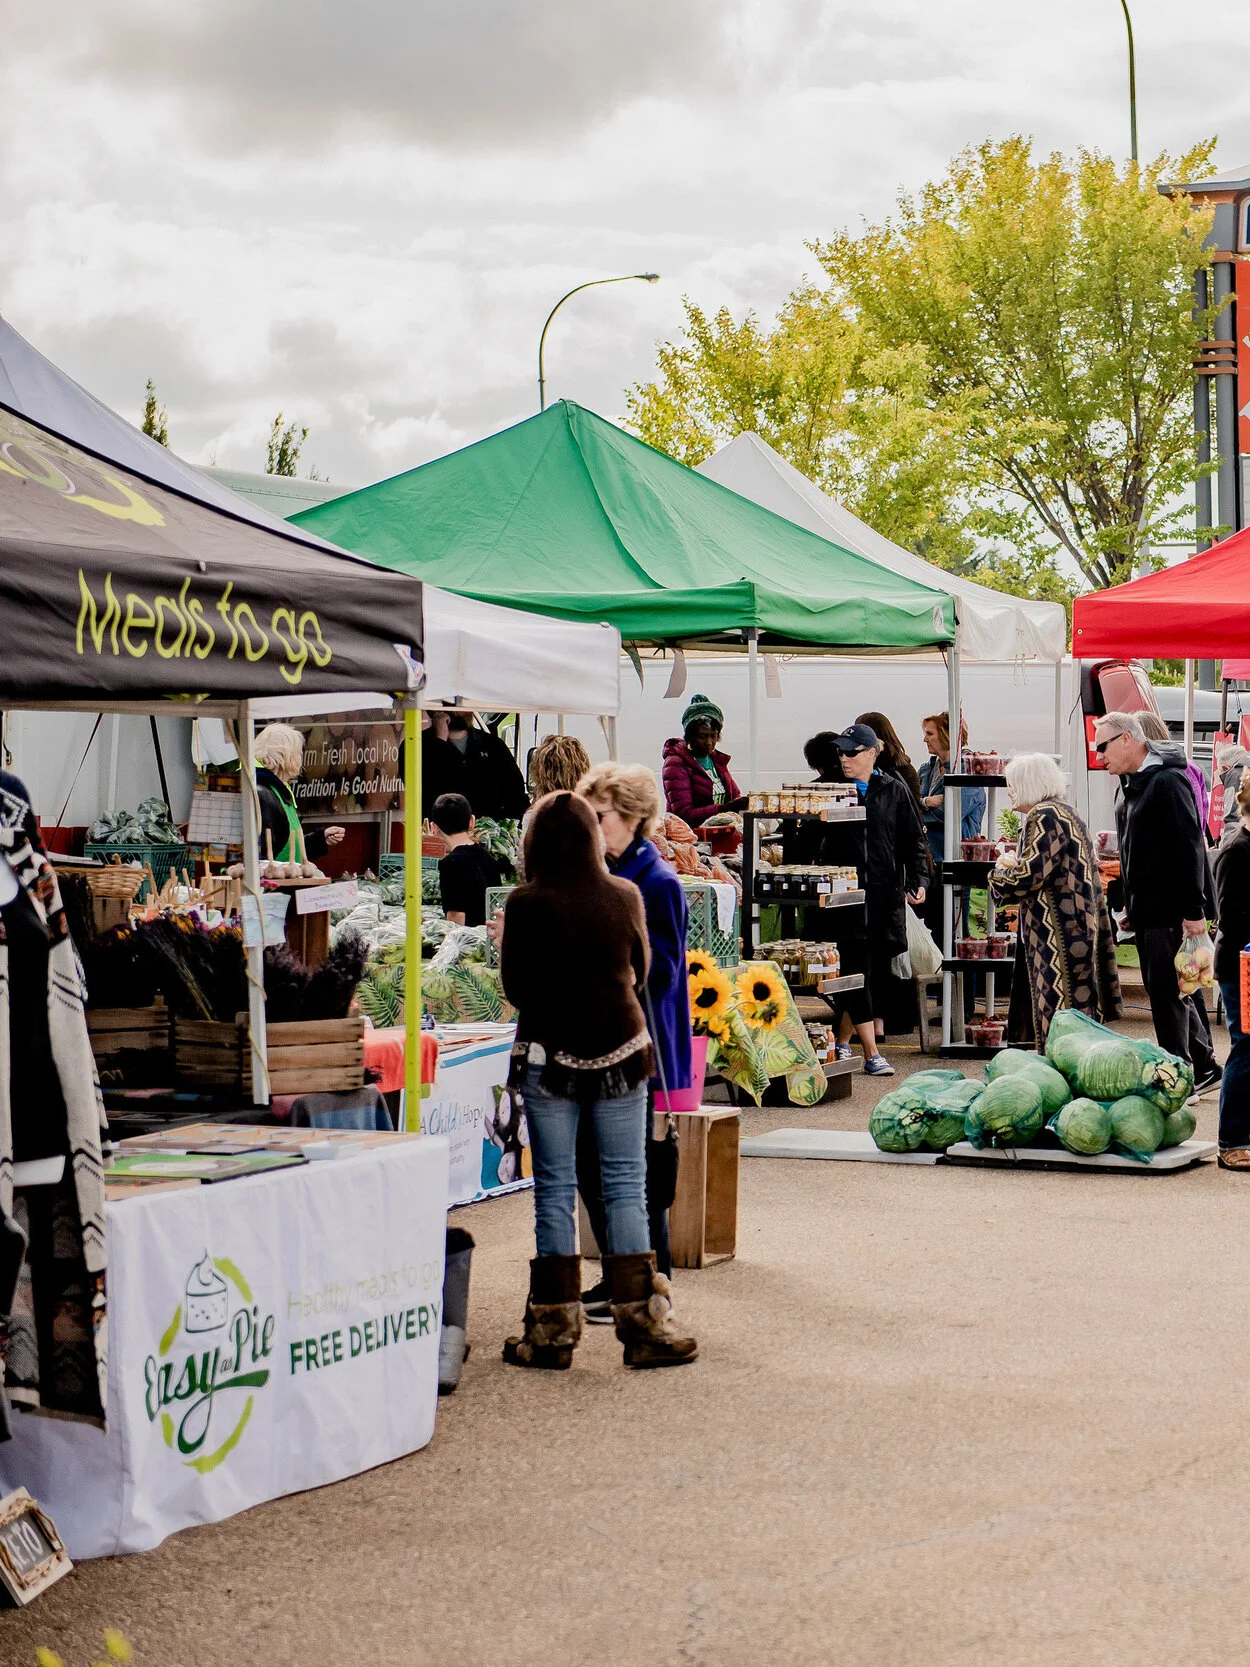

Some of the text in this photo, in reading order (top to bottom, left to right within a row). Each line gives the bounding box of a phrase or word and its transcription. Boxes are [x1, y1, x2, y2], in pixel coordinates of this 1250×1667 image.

[76, 568, 333, 685] Meals to go
[321, 741, 347, 767] Fresh
[351, 740, 379, 765] Local
[382, 739, 399, 762] Pro
[340, 776, 350, 796] Is
[352, 775, 379, 794] Good
[420, 1115, 427, 1135] A
[287, 1281, 350, 1321] Healthy
[357, 1264, 399, 1301] meals
[422, 1259, 442, 1291] go
[289, 1300, 442, 1375] FREE DELIVERY
[144, 1345, 236, 1454] Easy
[228, 1305, 275, 1373] Pie
